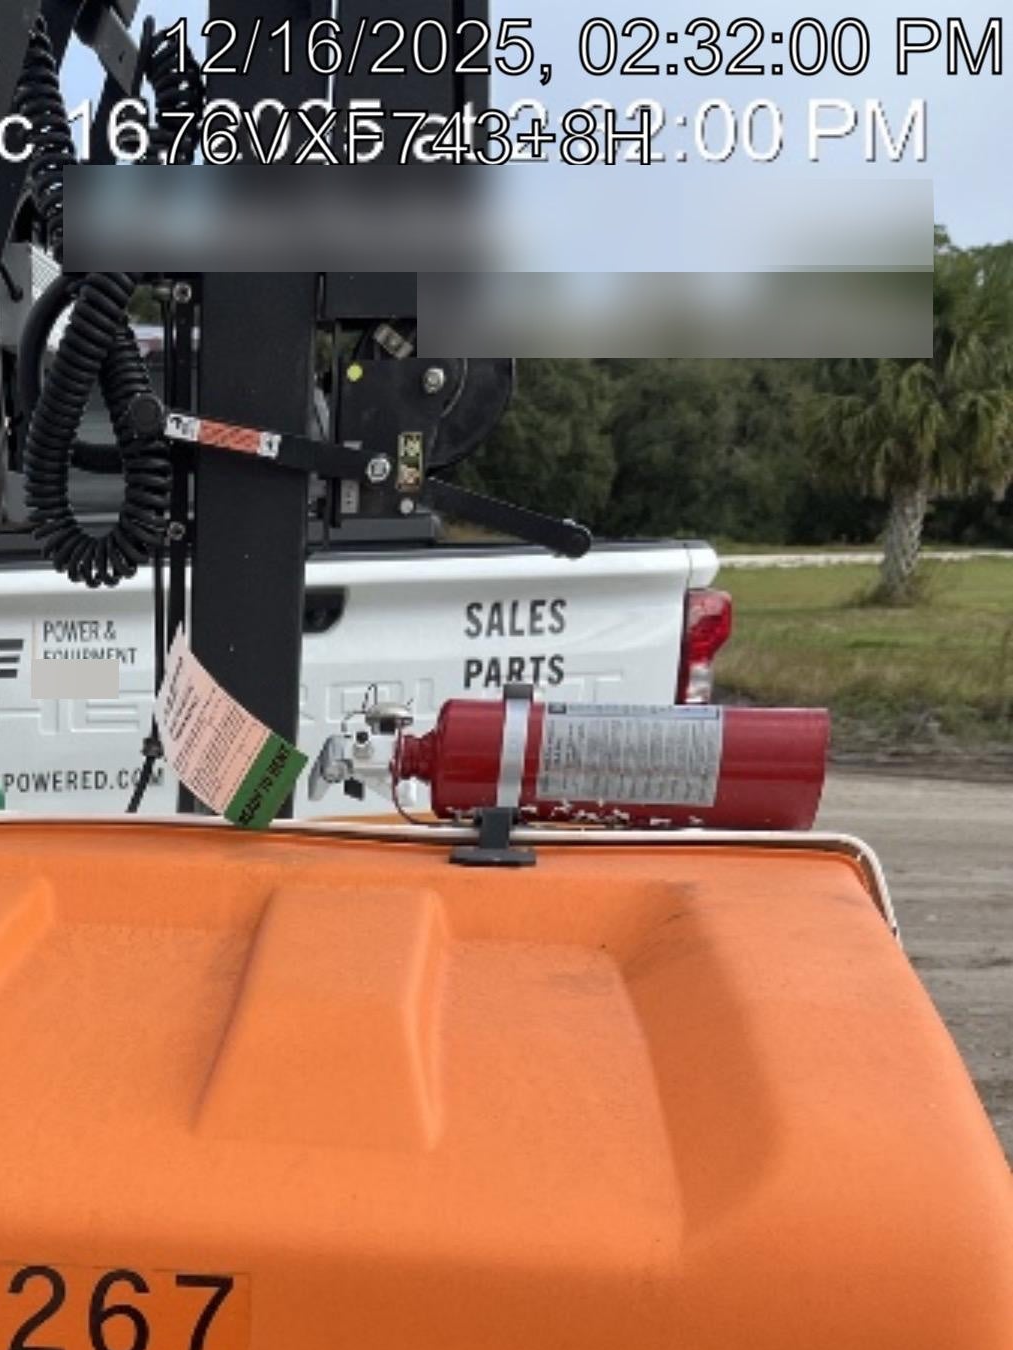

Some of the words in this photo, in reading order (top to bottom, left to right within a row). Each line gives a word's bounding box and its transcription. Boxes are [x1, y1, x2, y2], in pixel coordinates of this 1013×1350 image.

[43, 620, 100, 643] POWER
[103, 619, 117, 640] &
[463, 598, 567, 639] SALES
[462, 653, 565, 689] PARTS
